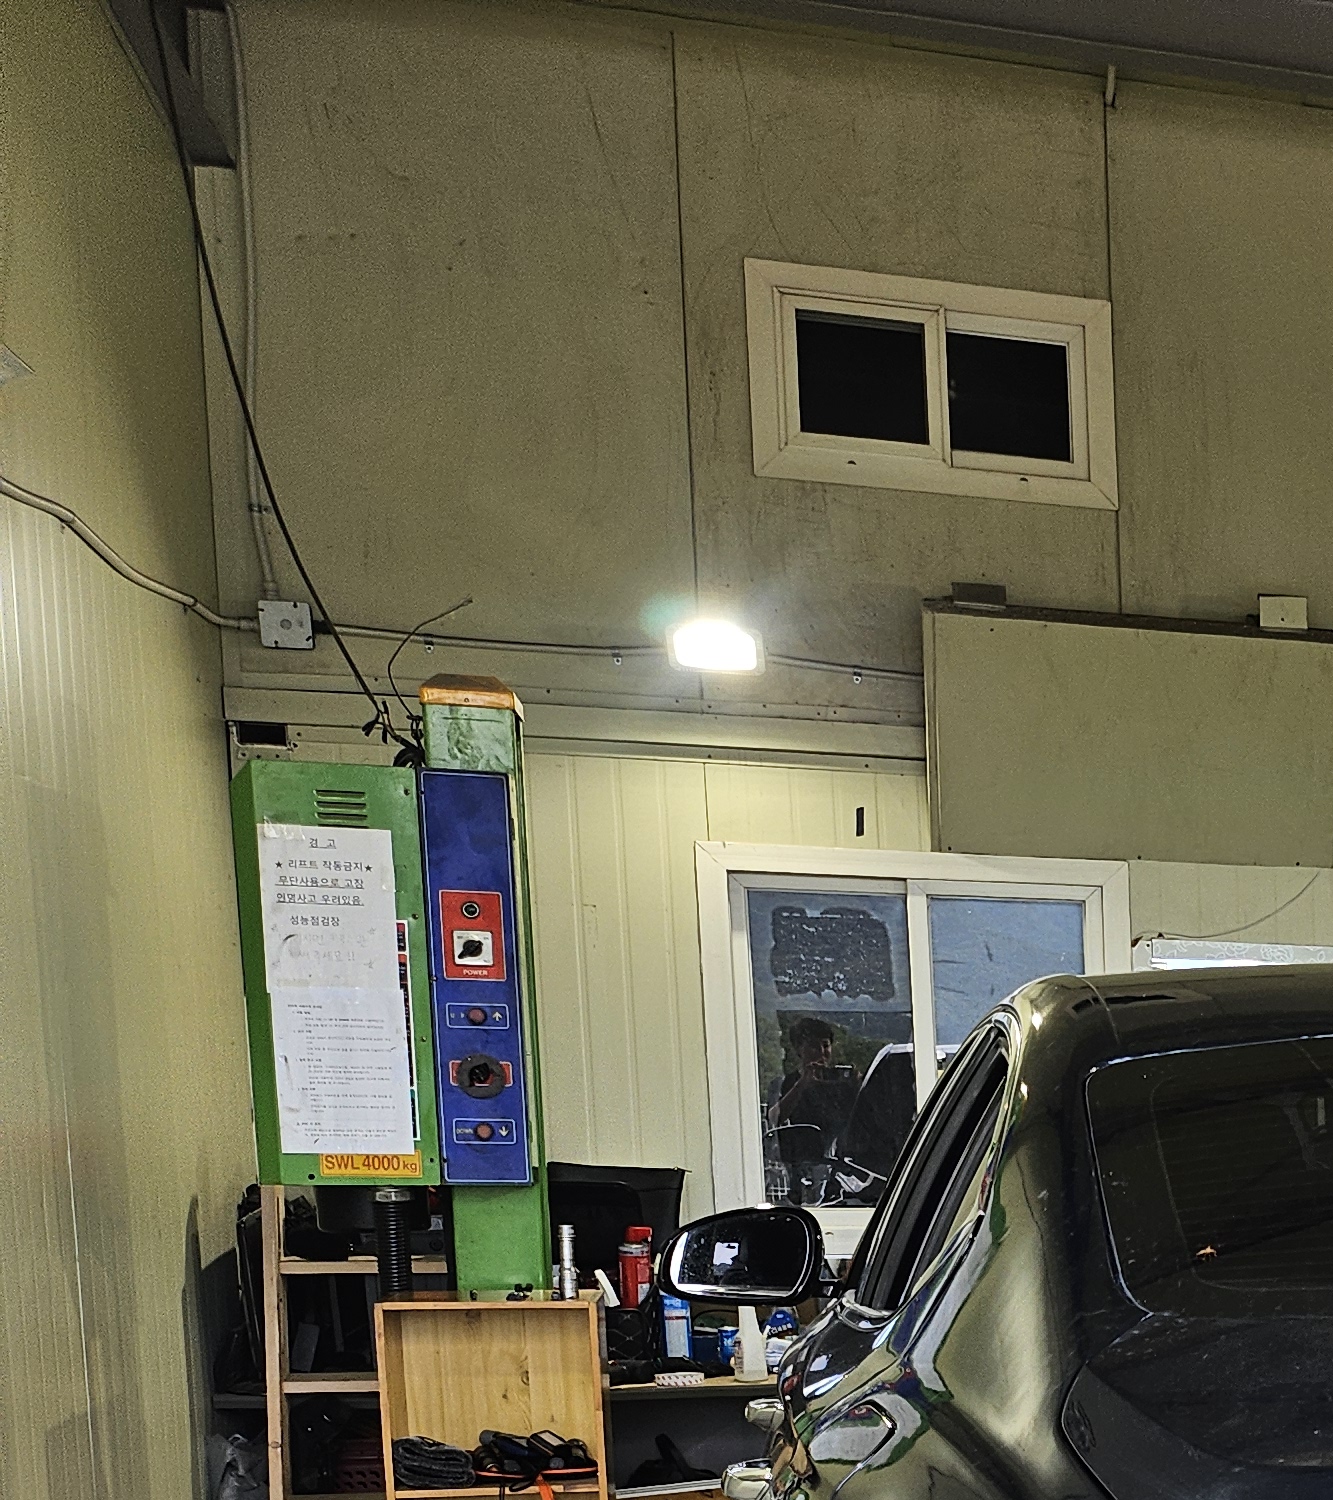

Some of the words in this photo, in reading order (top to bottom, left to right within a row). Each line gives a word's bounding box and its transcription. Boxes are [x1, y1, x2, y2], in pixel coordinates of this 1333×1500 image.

[288, 859, 319, 869] 리프트
[322, 860, 364, 872] 작동금지
[278, 875, 339, 887] 무단사용으로
[344, 878, 364, 889] 고장
[276, 892, 316, 904] 인명사고
[289, 915, 340, 927] 성능점검장
[462, 968, 489, 977] POWER
[324, 1154, 360, 1171] SWL
[362, 1154, 400, 1171] 4000
[402, 1158, 418, 1173] kg
